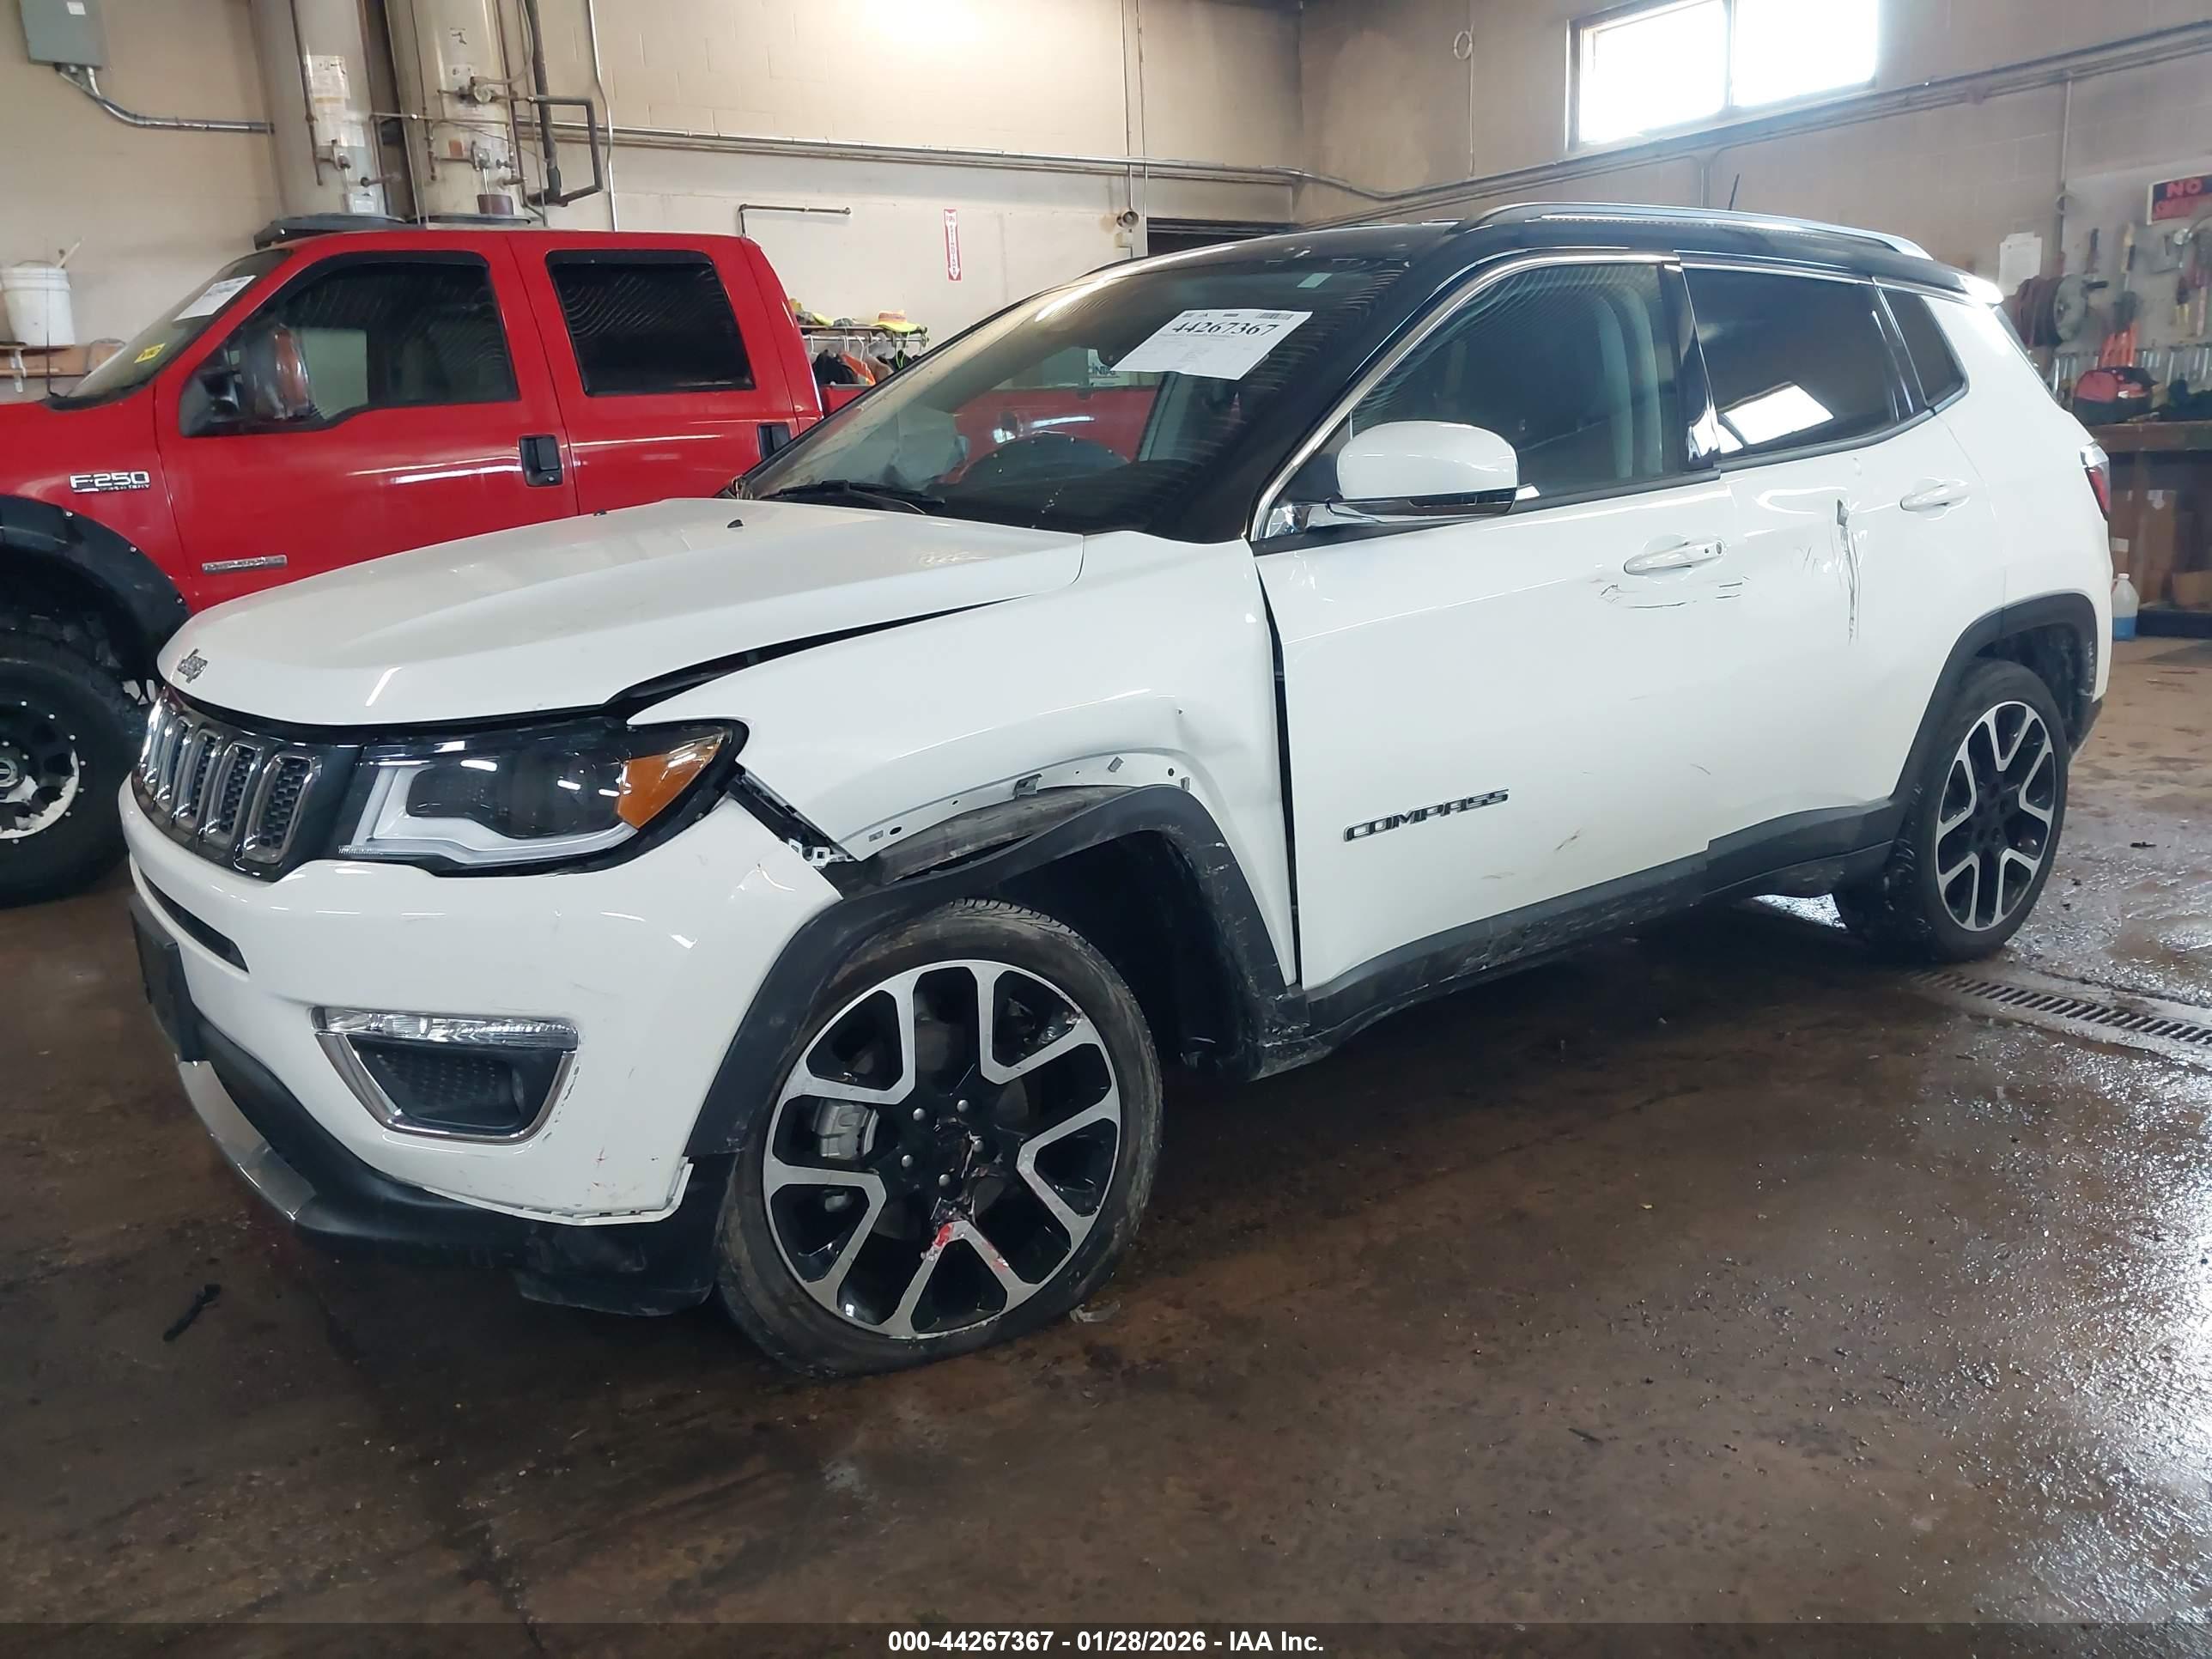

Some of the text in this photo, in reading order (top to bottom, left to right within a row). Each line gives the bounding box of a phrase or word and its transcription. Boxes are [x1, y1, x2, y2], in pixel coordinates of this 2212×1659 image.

[2166, 179, 2202, 198] NO
[1172, 321, 1280, 337] 44267367
[1343, 788, 1510, 842] COMPASS
